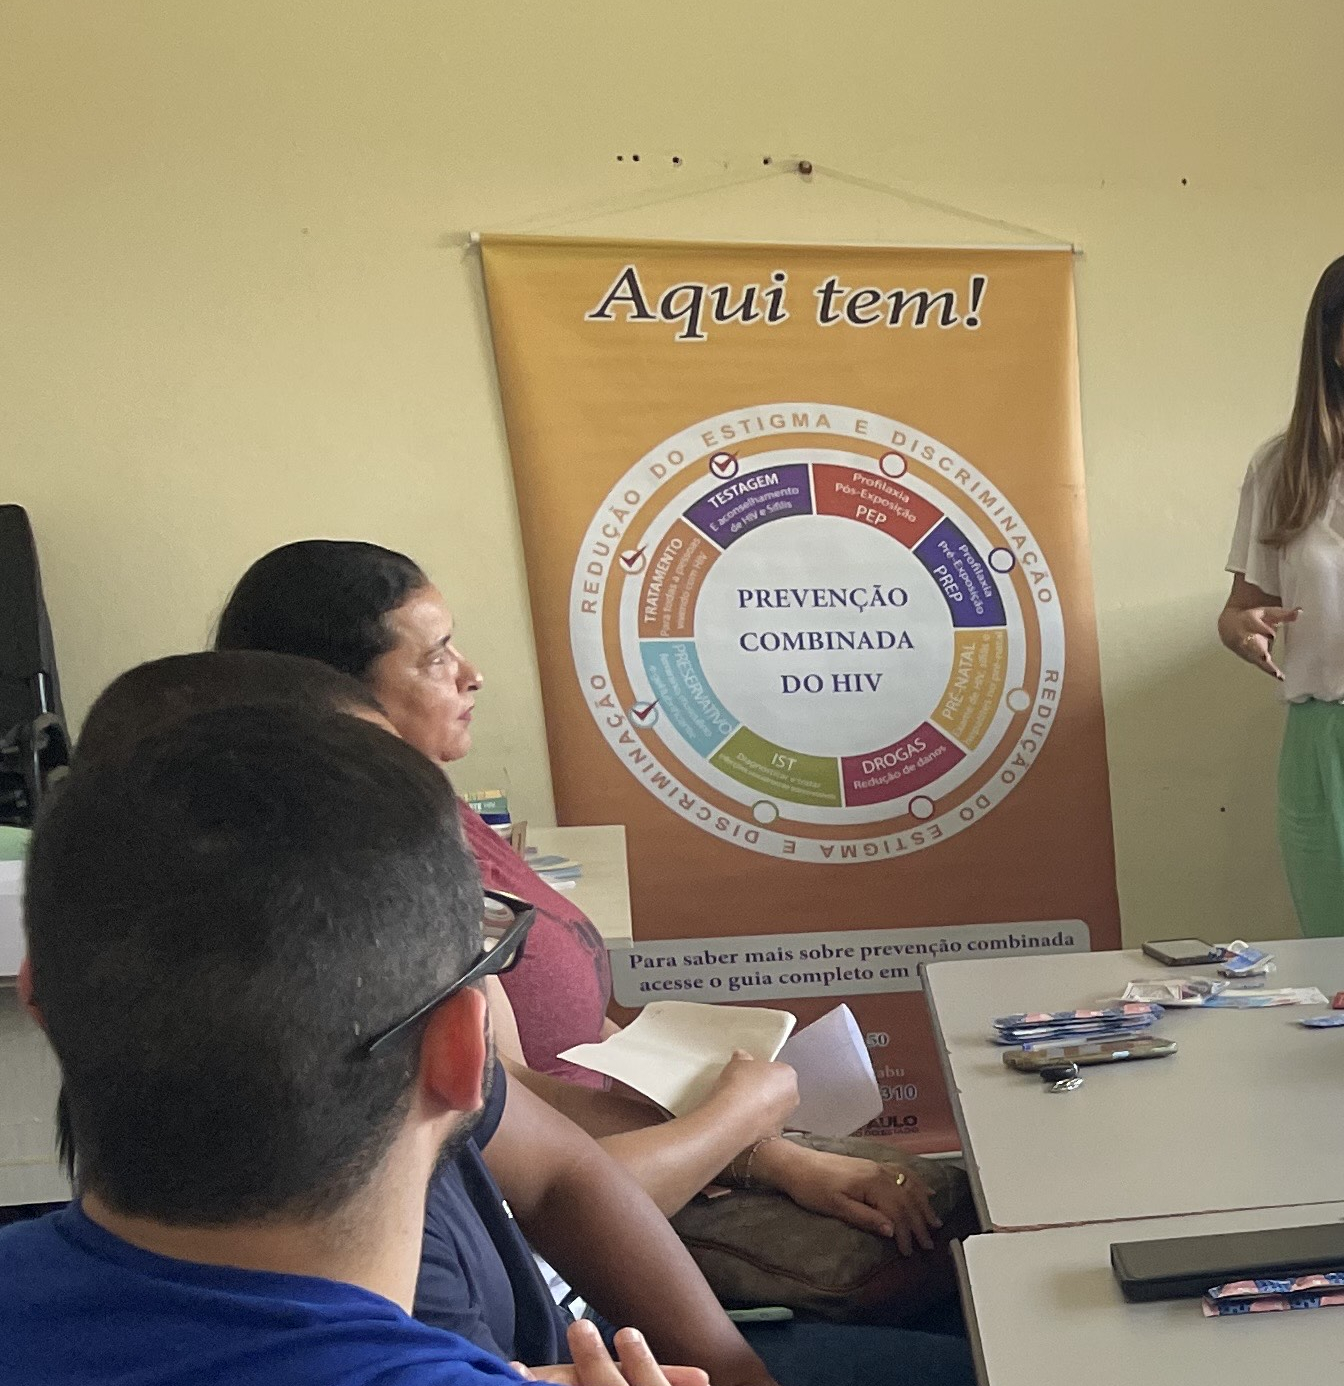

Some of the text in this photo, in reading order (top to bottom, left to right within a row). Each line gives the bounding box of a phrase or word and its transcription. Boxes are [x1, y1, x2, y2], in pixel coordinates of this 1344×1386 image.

[587, 265, 990, 340] Aqui tem!
[708, 473, 779, 509] TESTAGEM
[718, 486, 799, 526] aconselhamento
[835, 482, 917, 523] Pós-Exposição
[853, 472, 909, 503] Profilaxia
[581, 413, 1052, 614] REDUÇÃO DO ESTIGMA E DISCRIMINAÇÃO
[730, 522, 741, 533] de
[741, 512, 759, 528] HIV
[855, 504, 887, 526] PEP
[644, 538, 683, 624] TRATAMENTO
[933, 564, 964, 602] PREP
[937, 540, 984, 615] Pré-Exposição
[959, 544, 992, 598] Profilaxia
[737, 585, 908, 613] PREVENÇÃO
[740, 631, 914, 651] COMBINADA
[673, 643, 734, 735] PRESERVATIVO
[781, 673, 883, 693] DO HIV
[942, 643, 976, 720] PRÉ-NATAL
[1001, 669, 1059, 785] REDUÇÃO
[590, 675, 760, 844] DISCRIMINAÇÃO
[771, 752, 798, 771] IST
[853, 770, 901, 790] Redução
[902, 764, 916, 777] de
[917, 744, 947, 772] danos
[862, 737, 927, 775] DROGAS
[959, 794, 991, 822] DO
[783, 839, 796, 854] E
[820, 824, 943, 859] ESTIGMA
[629, 931, 1075, 971] Para saber mais sobre prevenção combinada
[639, 974, 705, 993] acesse
[710, 975, 722, 989] o
[728, 969, 773, 993] guia
[779, 964, 874, 989] completo
[878, 964, 910, 980] em
